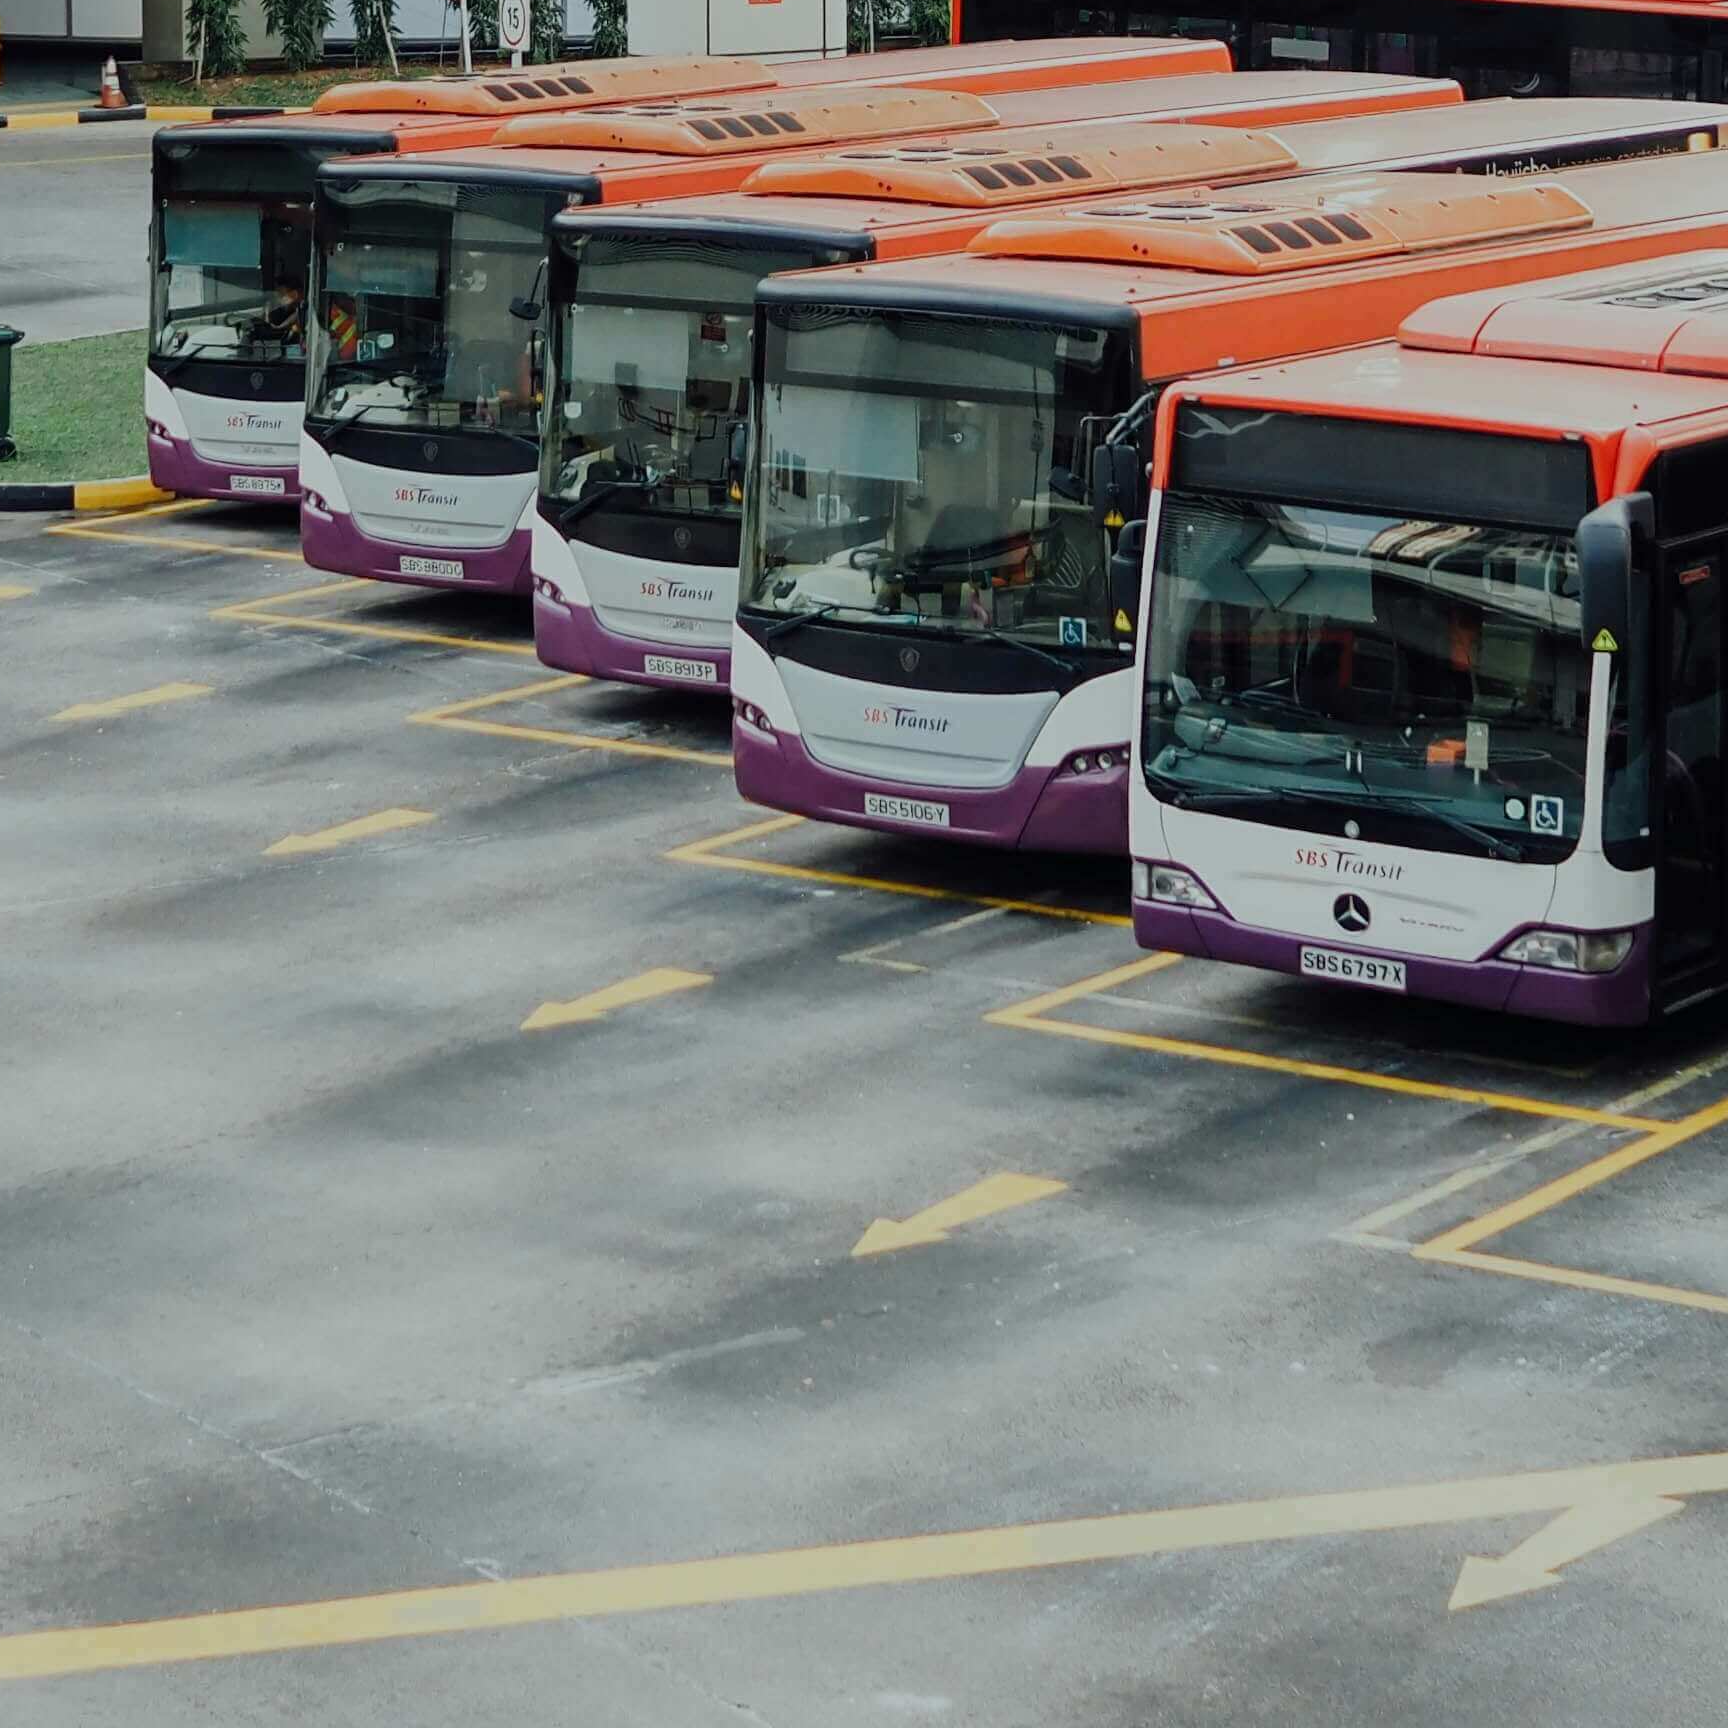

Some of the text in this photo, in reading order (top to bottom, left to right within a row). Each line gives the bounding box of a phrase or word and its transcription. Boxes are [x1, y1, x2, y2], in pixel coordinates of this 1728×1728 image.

[507, 7, 520, 29] 15
[395, 488, 458, 506] SBS Transit
[641, 581, 714, 601] SBS Transit
[864, 706, 952, 733] SBS Transit
[868, 797, 945, 823] SBS5106Y
[1295, 848, 1406, 881] SBS Transit
[1303, 951, 1403, 985] SBS6797X
